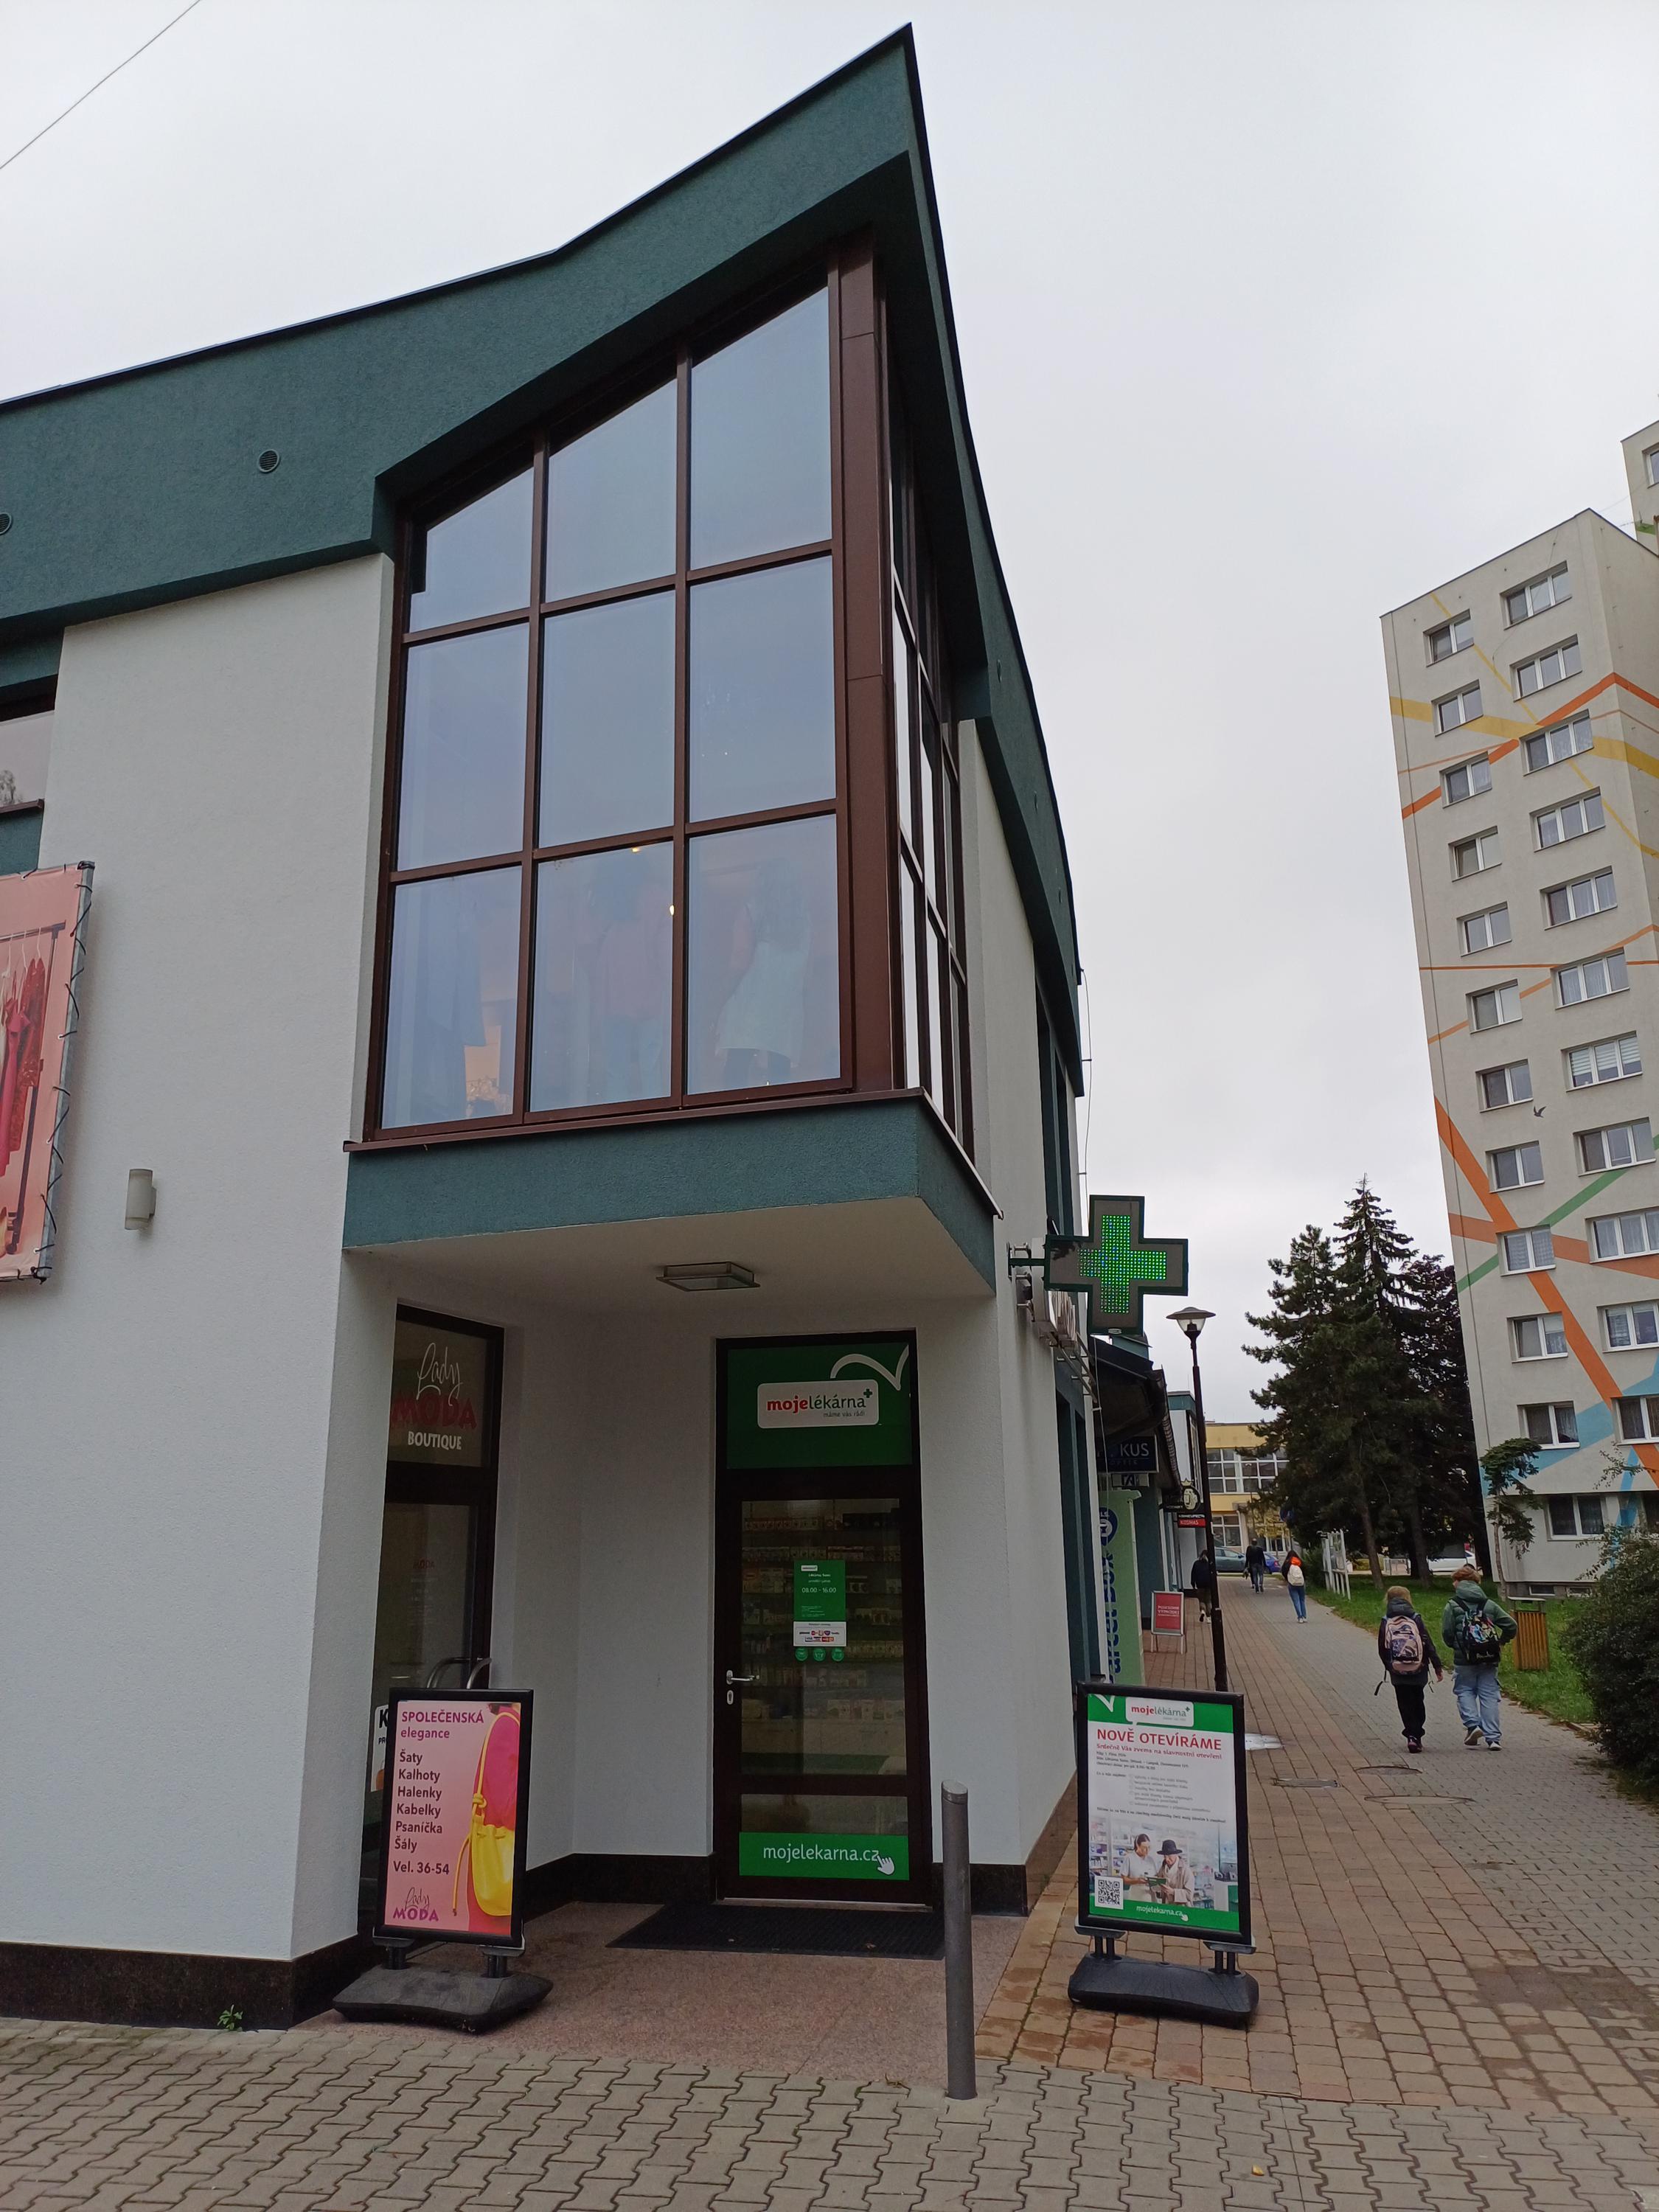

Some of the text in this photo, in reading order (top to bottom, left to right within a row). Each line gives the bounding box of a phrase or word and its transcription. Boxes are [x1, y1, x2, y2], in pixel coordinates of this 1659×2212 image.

[416, 1343, 463, 1406] Lady
[391, 1390, 477, 1429] MODA
[767, 1394, 866, 1413] mojelékárna
[408, 1430, 462, 1450] BOUTIQUE
[1120, 1443, 1150, 1457] KUS
[402, 1709, 484, 1723] SPOLEČENSKÁ
[1131, 1705, 1186, 1717] mojelékárna
[400, 1726, 450, 1741] elegance
[1097, 1728, 1222, 1750] NOVĚ OTEVÍRÁME
[400, 1748, 422, 1766] Šaty
[398, 1768, 440, 1784] Kalhoty
[397, 1786, 442, 1801] Halenky
[397, 1803, 441, 1819] Kabelky
[395, 1820, 442, 1834] Psaníčka
[394, 1835, 417, 1854] Šály
[762, 1843, 880, 1863] mojelekarna.cz
[393, 1860, 450, 1875] Vel. 36-54
[405, 1887, 430, 1913] Lady
[393, 1907, 439, 1921] MODA
